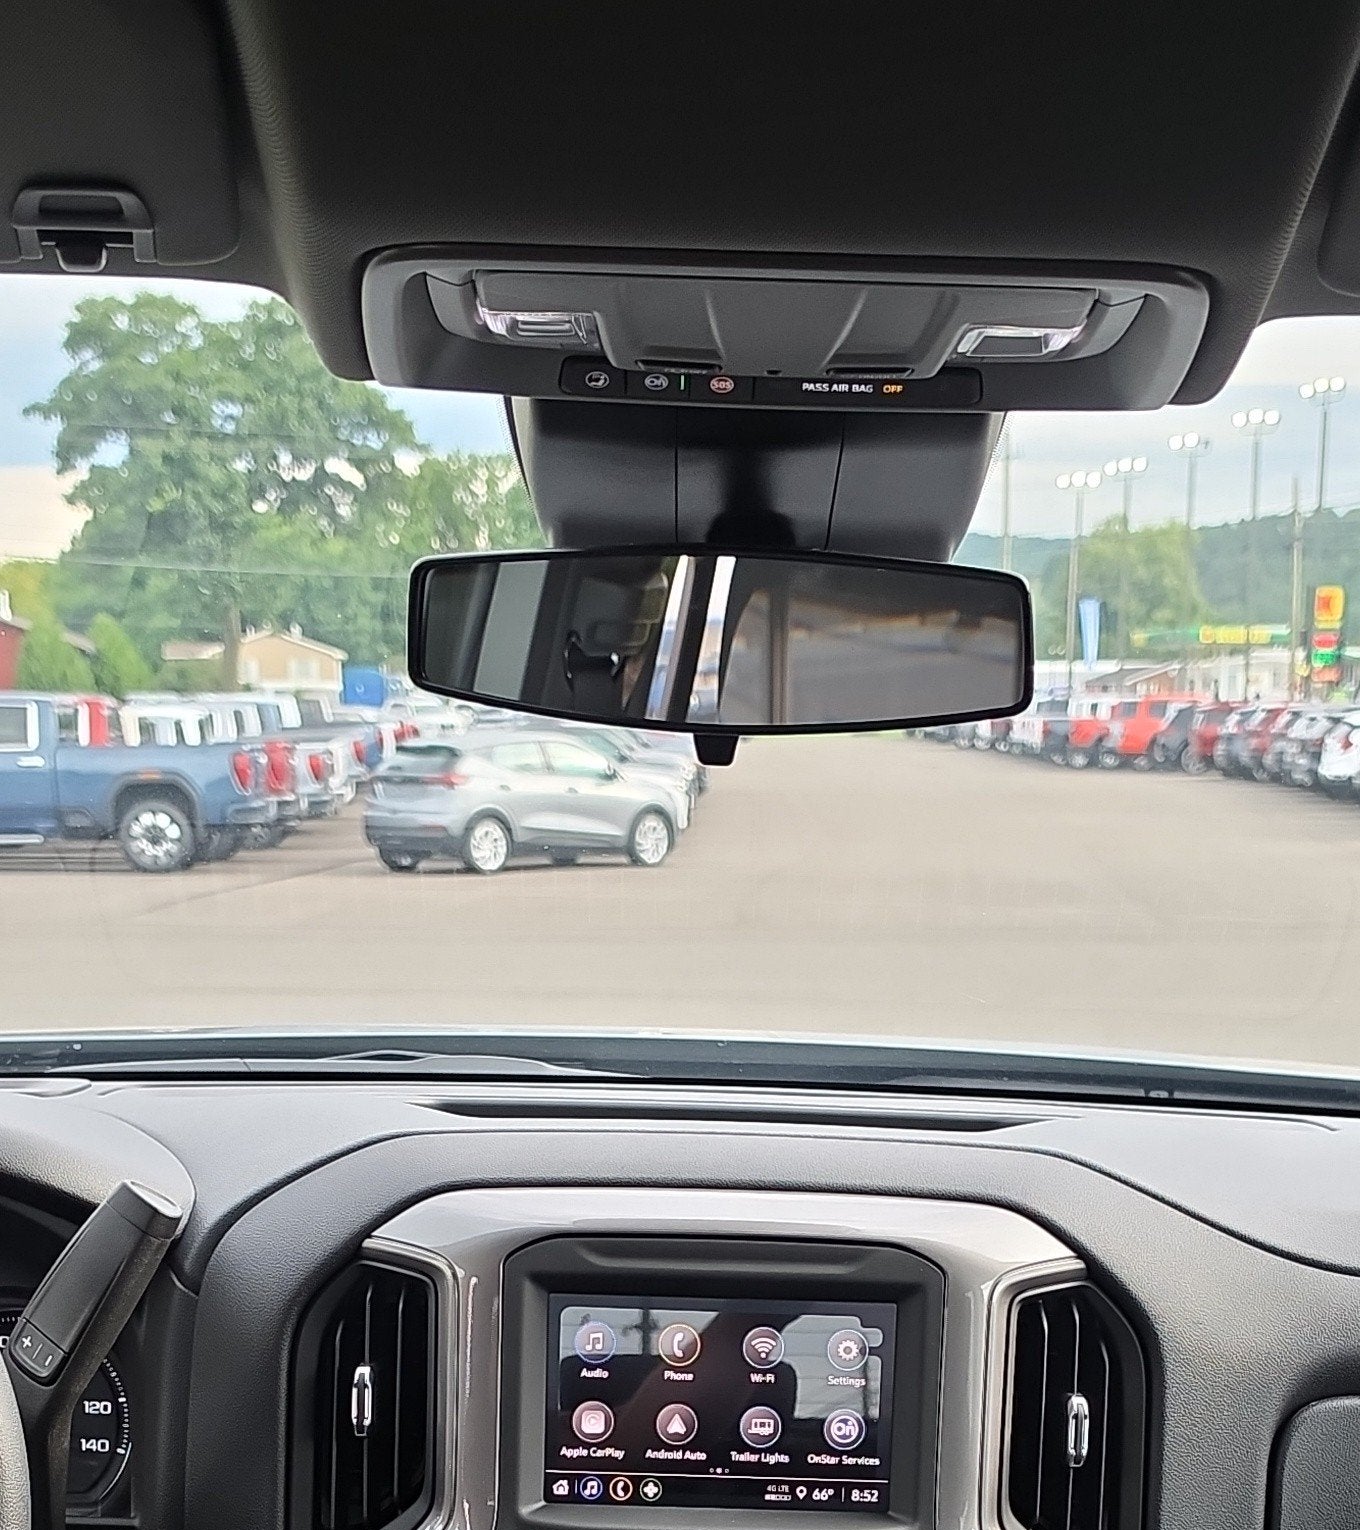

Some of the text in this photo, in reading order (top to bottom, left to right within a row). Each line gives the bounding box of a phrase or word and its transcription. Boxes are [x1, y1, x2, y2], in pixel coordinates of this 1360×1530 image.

[712, 378, 733, 390] SOS
[802, 381, 904, 394] PASS AIR BAG OFF
[580, 1367, 610, 1380] Audio
[663, 1370, 694, 1383] Phone
[749, 1372, 776, 1384] Wi-Fi
[827, 1374, 867, 1388] Settings
[82, 1399, 113, 1415] 120
[79, 1437, 110, 1453] 140
[559, 1446, 626, 1461] Apple CarPlay
[644, 1448, 707, 1462] Android Auto
[730, 1450, 790, 1465] Trailer Lights
[806, 1453, 881, 1467] OnStar Services
[766, 1484, 790, 1493] 4G LTE
[850, 1488, 879, 1503] 8:52
